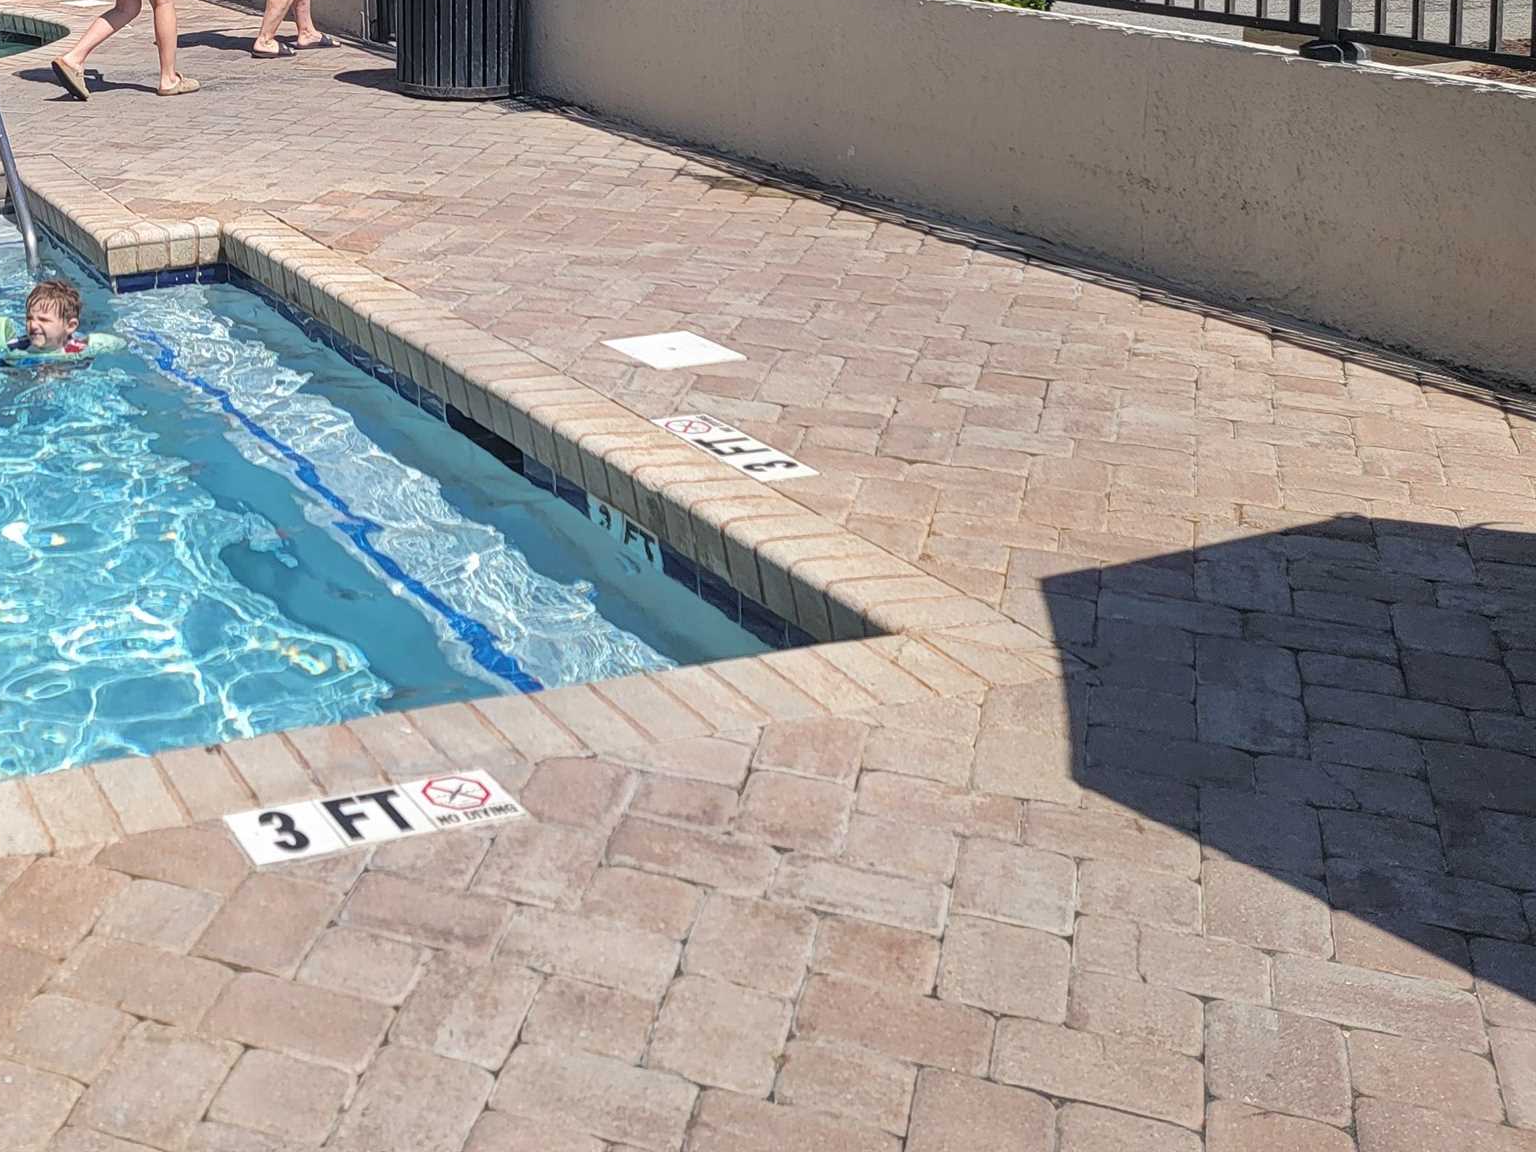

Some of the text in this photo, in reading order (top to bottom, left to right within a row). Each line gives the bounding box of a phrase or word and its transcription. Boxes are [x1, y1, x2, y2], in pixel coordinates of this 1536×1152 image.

[624, 521, 655, 563] FT
[258, 789, 415, 852] 3 FT
[436, 803, 518, 826] NO DIVING
